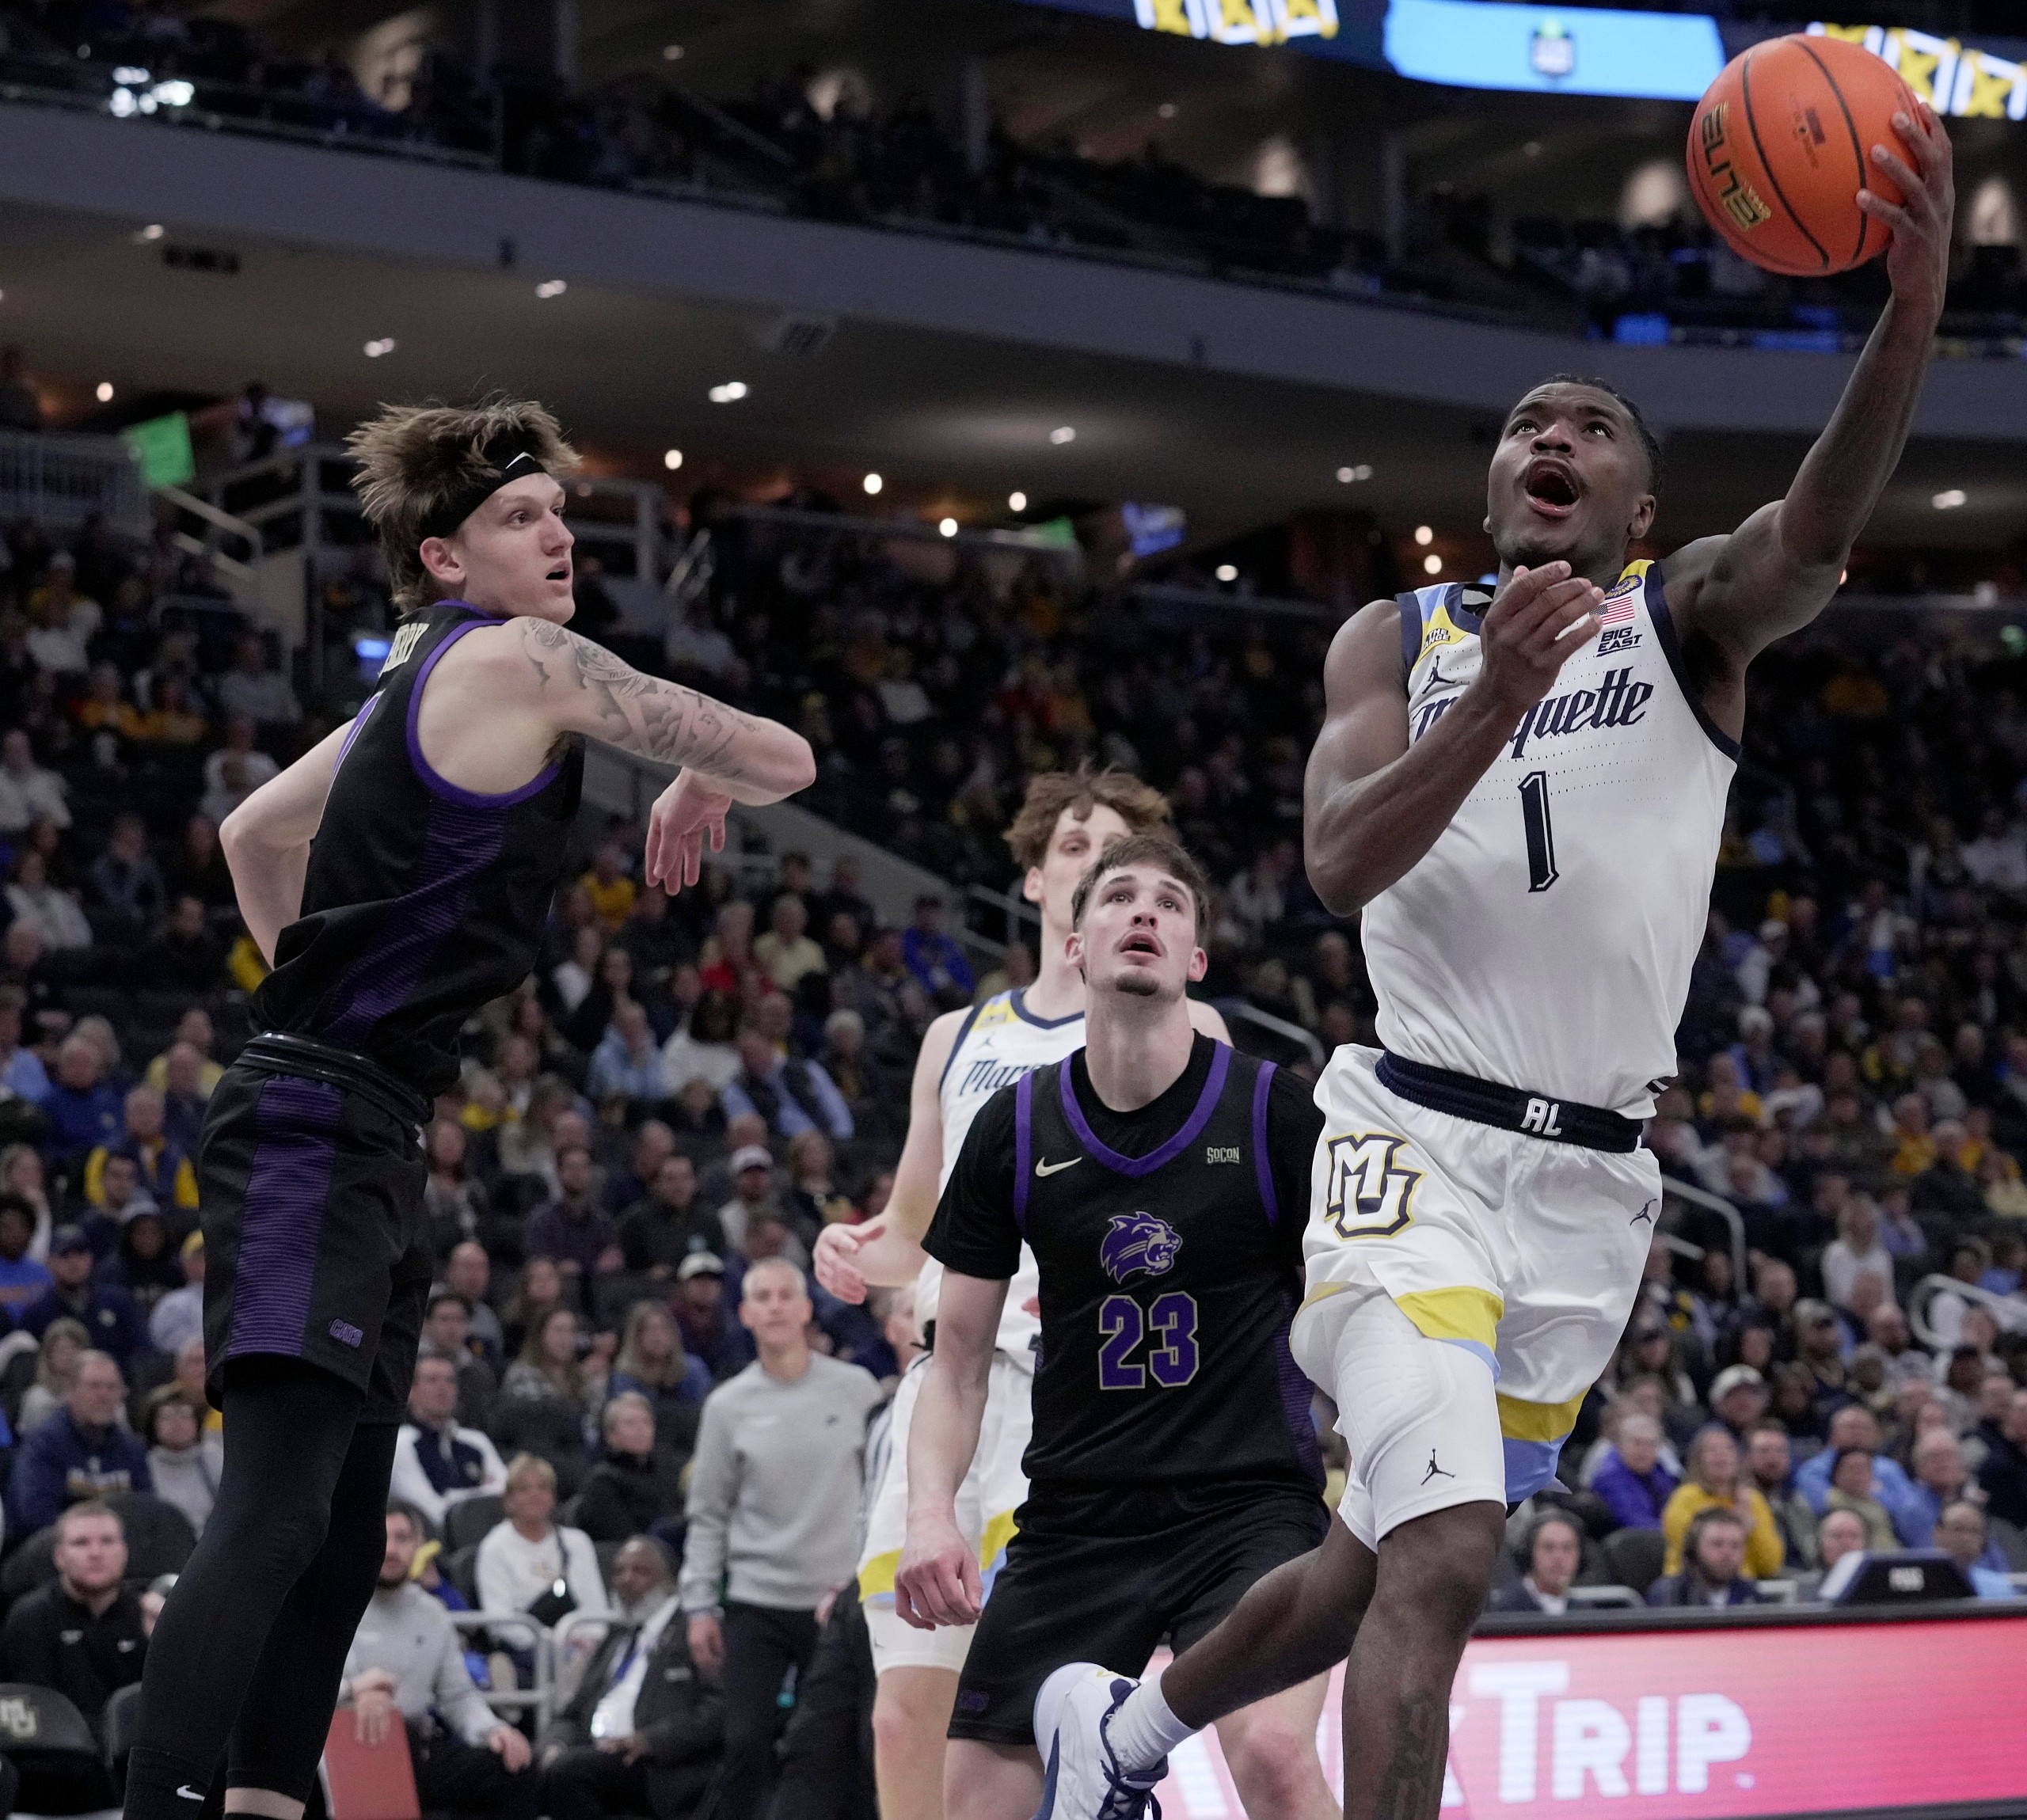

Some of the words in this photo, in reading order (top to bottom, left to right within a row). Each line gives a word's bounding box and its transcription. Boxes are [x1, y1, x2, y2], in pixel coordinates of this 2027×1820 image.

[1702, 104, 1761, 230] ELITE
[1597, 634, 1643, 652] EAST
[1600, 626, 1633, 643] BIG
[1413, 666, 1654, 759] Mquette
[1517, 770, 1560, 893] 1
[1519, 1097, 1562, 1136] AL
[1325, 1131, 1428, 1241] MU
[1098, 1291, 1200, 1390] 23
